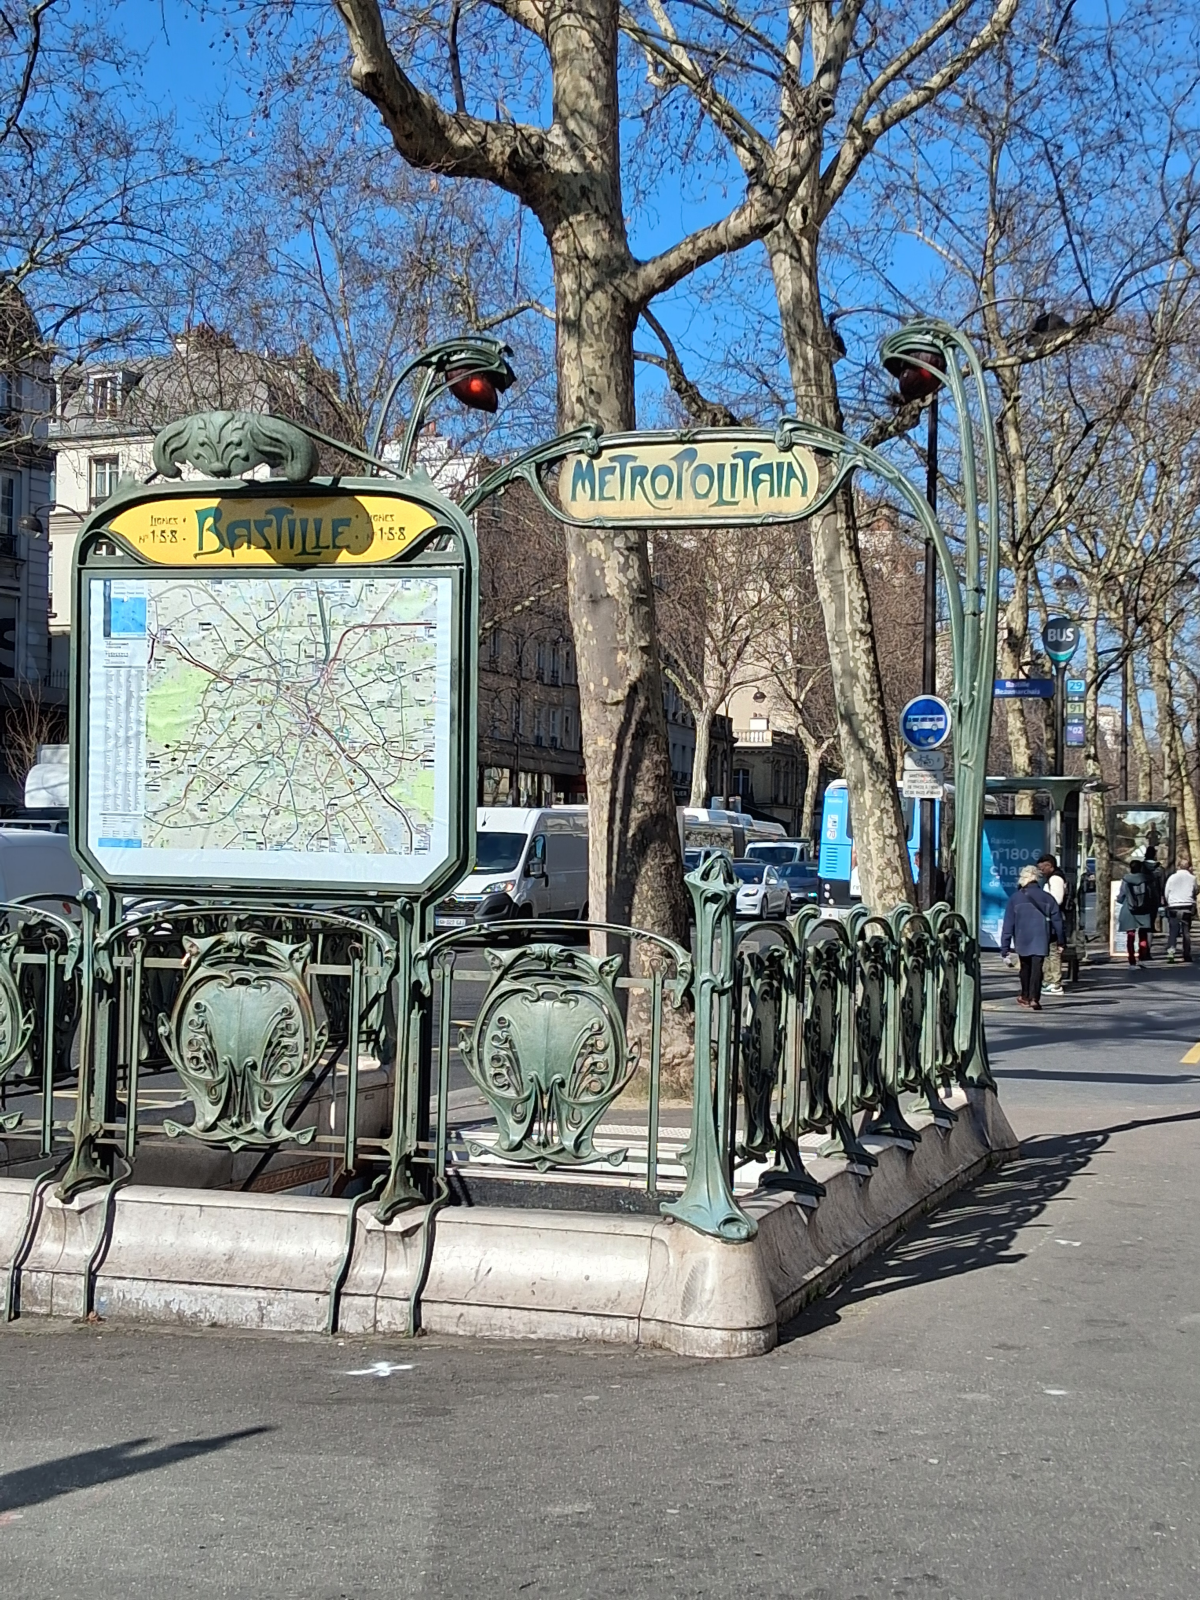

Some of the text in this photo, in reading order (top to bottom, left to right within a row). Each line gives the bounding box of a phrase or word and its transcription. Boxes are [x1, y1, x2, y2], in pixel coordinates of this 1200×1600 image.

[570, 446, 808, 511] METROPOLITAIN
[193, 506, 352, 560] BASTILLE
[1047, 627, 1075, 642] BUS
[1070, 681, 1083, 690] 29
[1069, 703, 1081, 712] 91
[990, 837, 1016, 845] Raison
[989, 879, 1000, 888] de
